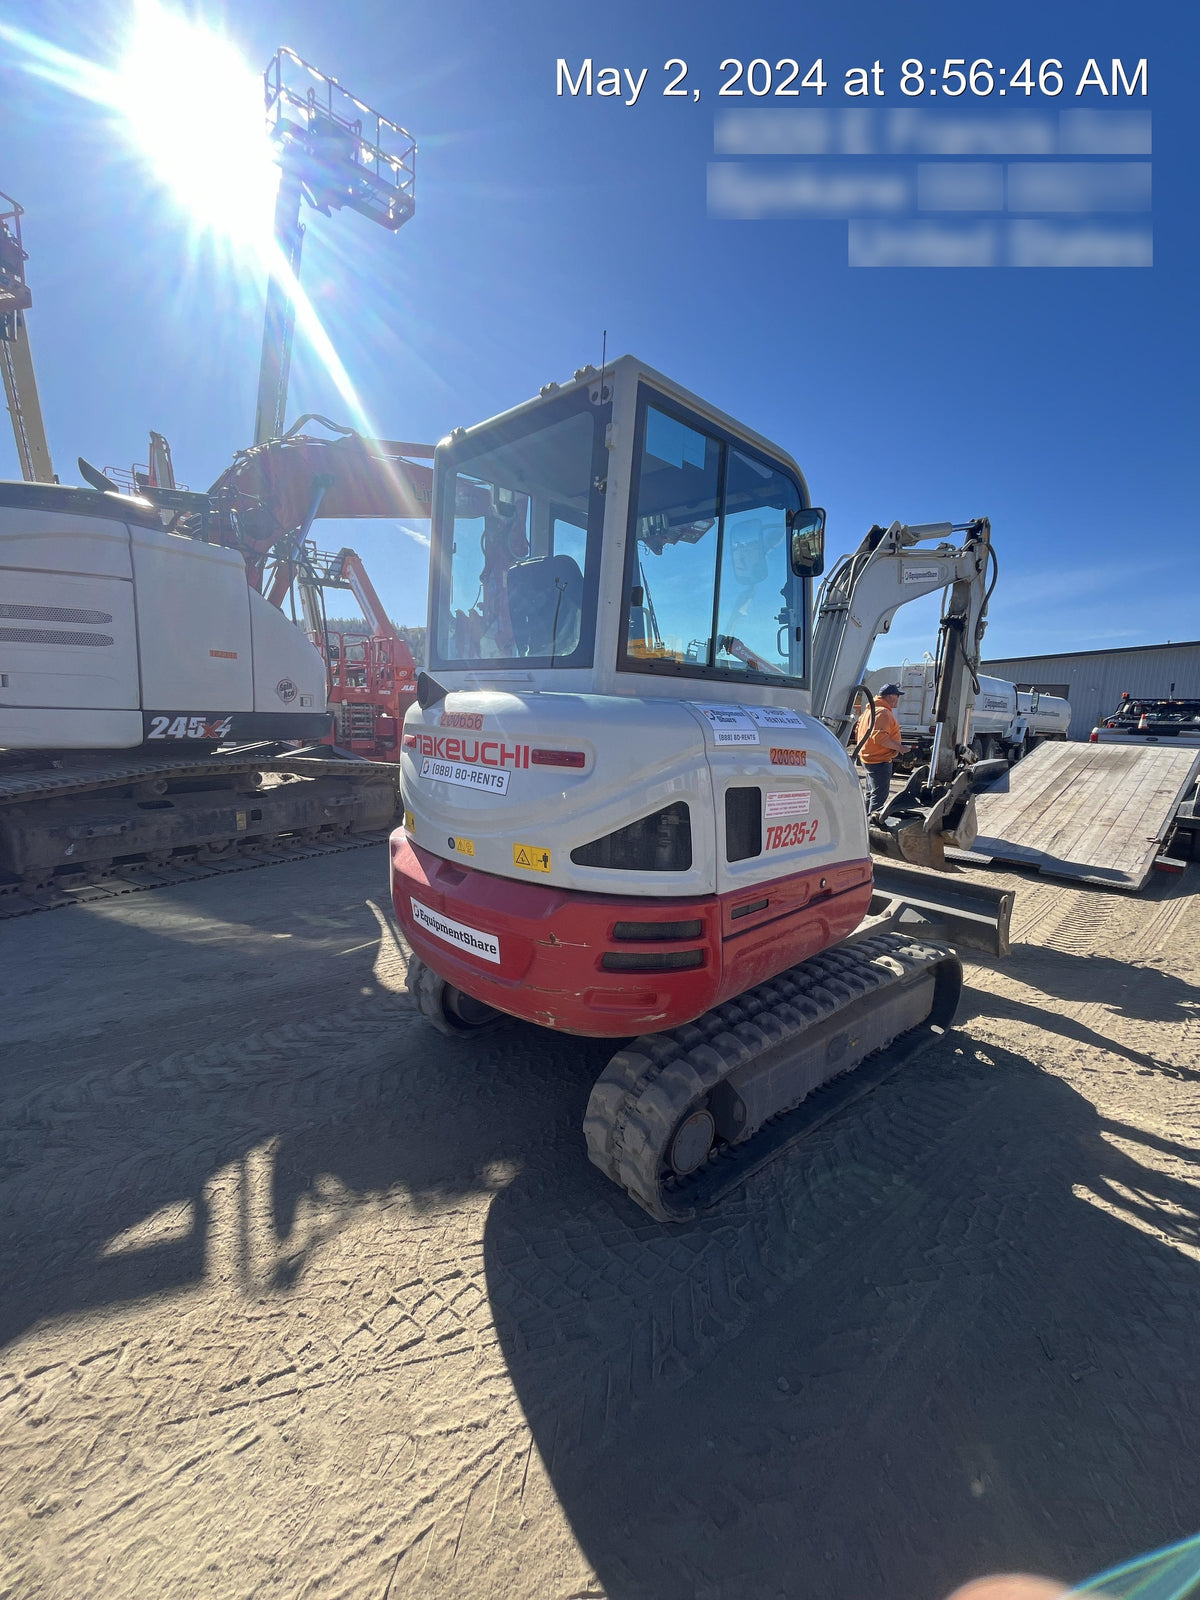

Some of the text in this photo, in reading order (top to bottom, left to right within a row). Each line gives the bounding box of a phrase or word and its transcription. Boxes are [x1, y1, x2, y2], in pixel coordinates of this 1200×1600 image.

[441, 711, 483, 730] 200656
[770, 748, 807, 766] 200656
[431, 763, 505, 788] (888) 80-RENTS
[765, 818, 819, 851] TB235-2
[419, 907, 498, 955] EquipmentShare
